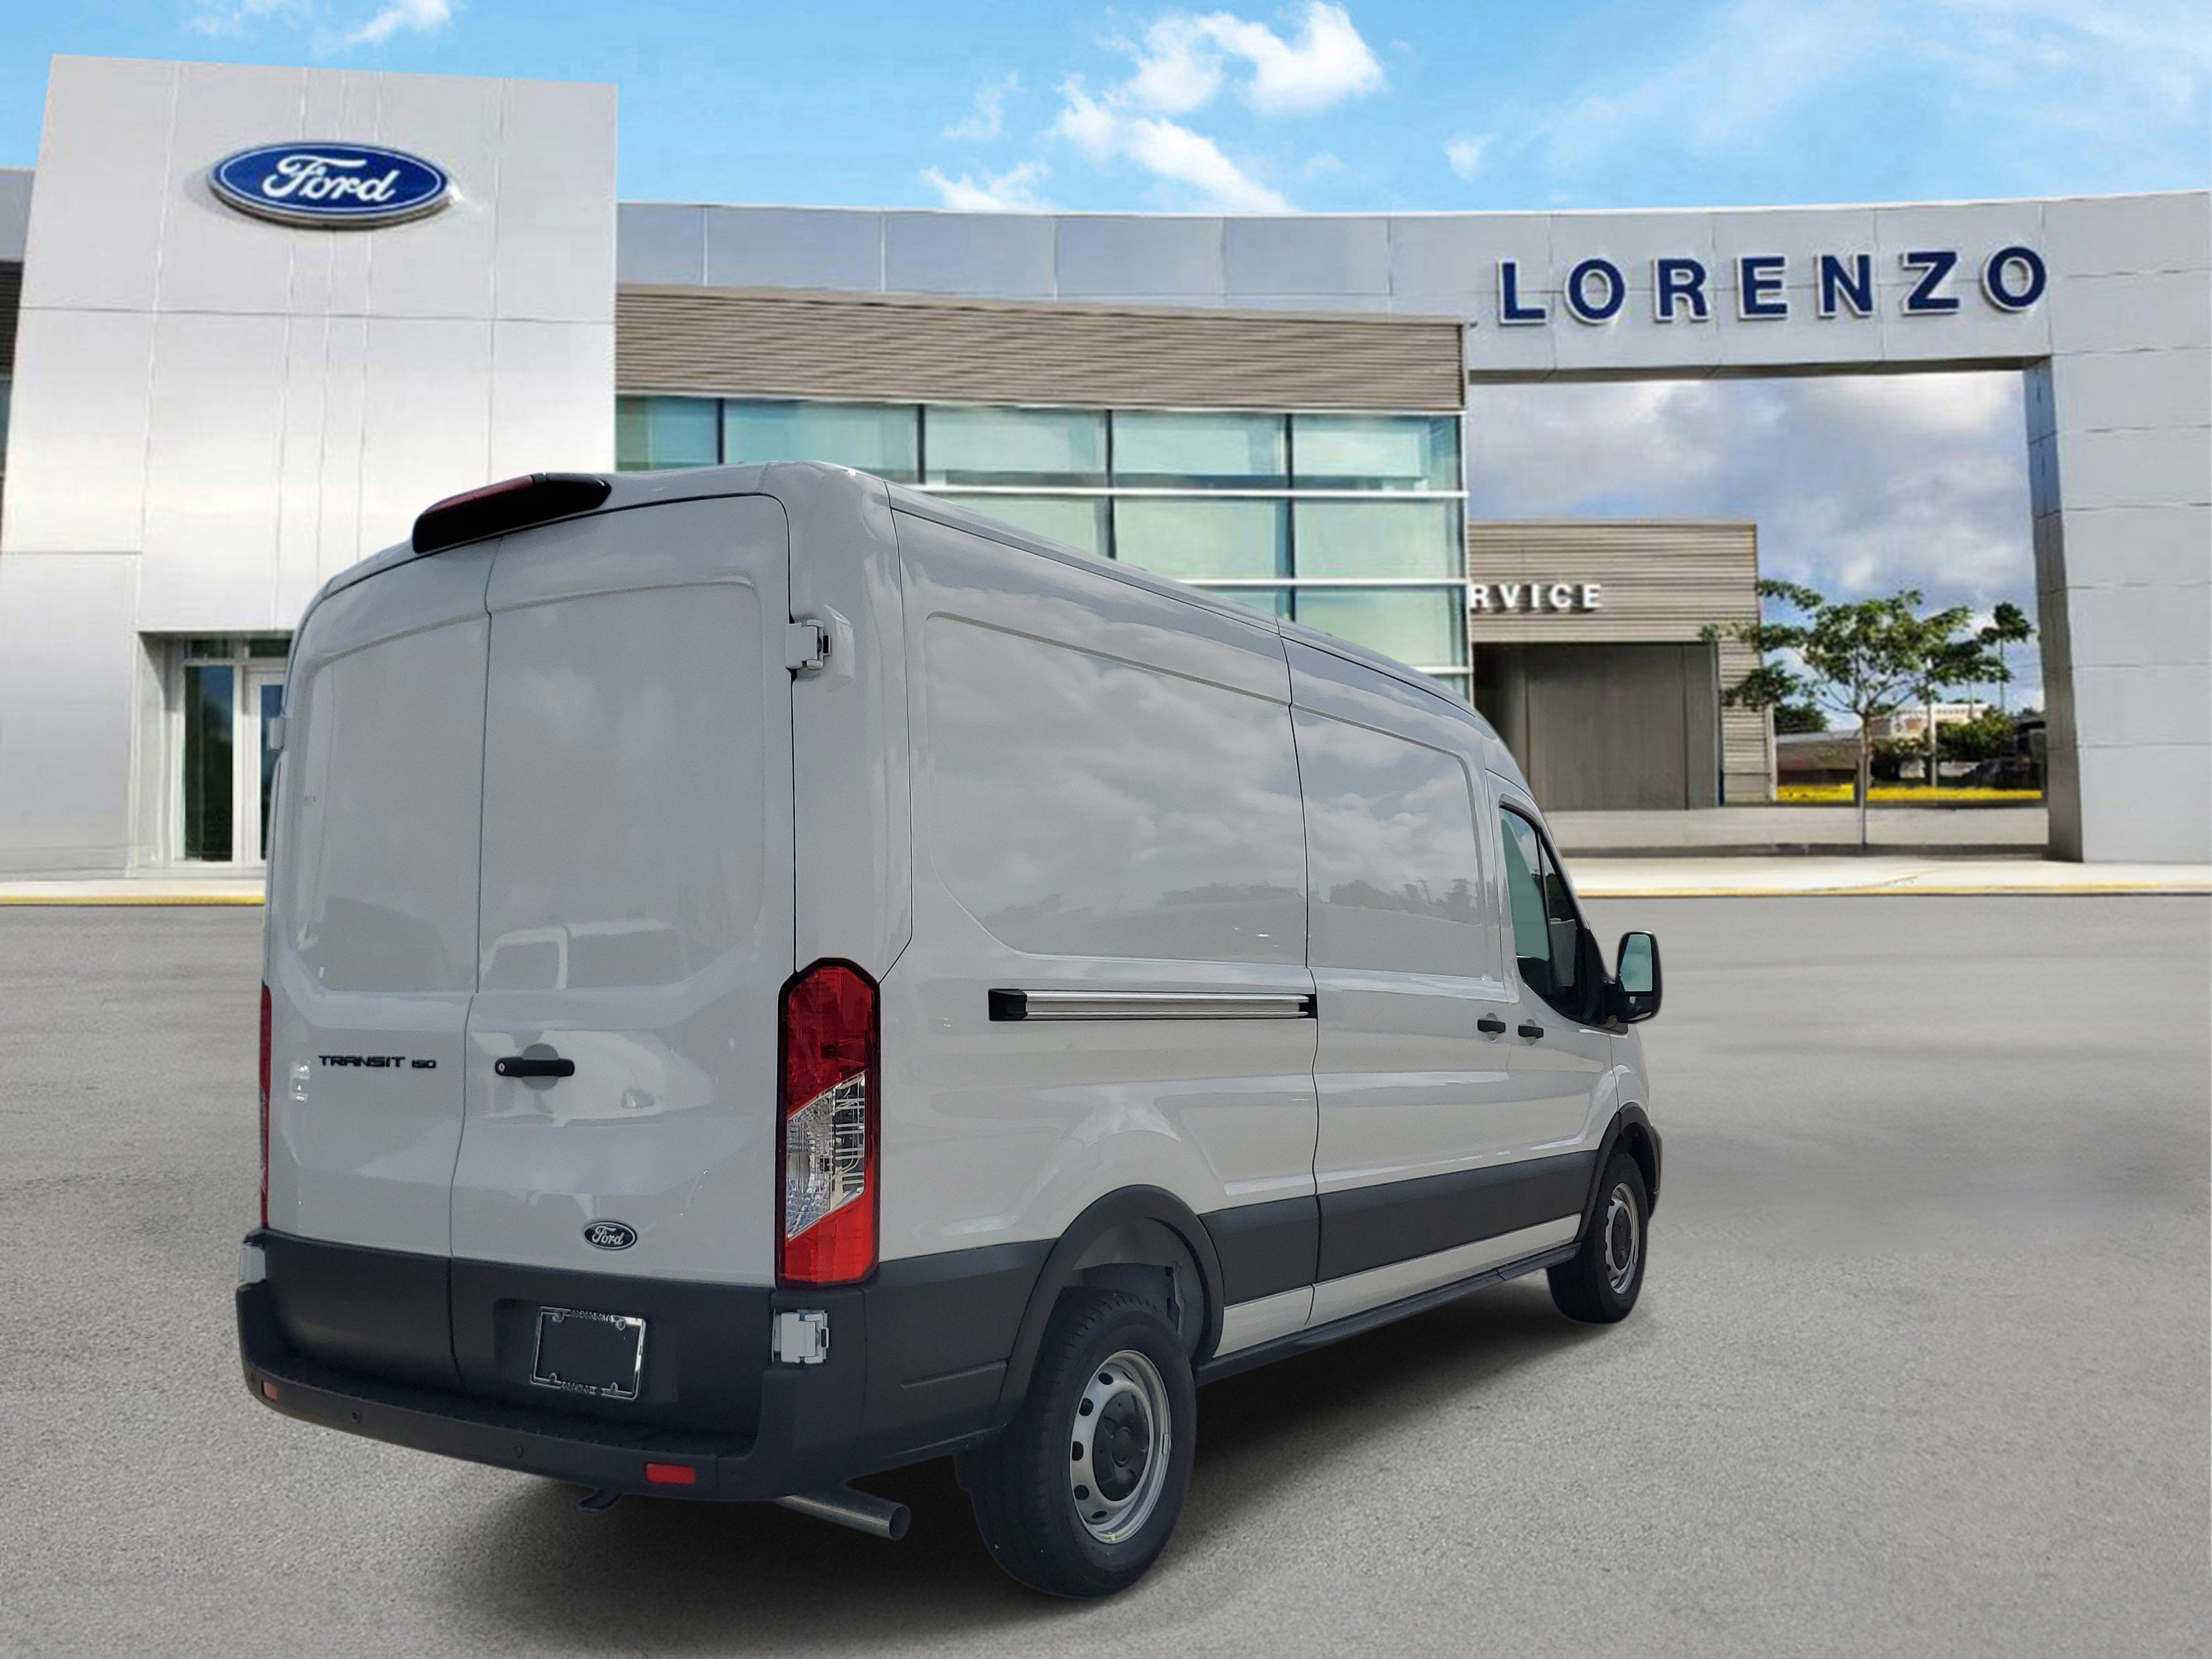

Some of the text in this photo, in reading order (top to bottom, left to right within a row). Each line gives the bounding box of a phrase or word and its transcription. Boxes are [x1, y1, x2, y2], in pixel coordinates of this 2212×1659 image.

[262, 154, 400, 201] Ford
[1496, 246, 2047, 325] LORENZO
[318, 1055, 436, 1069] TRANSIT 150
[592, 1226, 625, 1245] Ford
